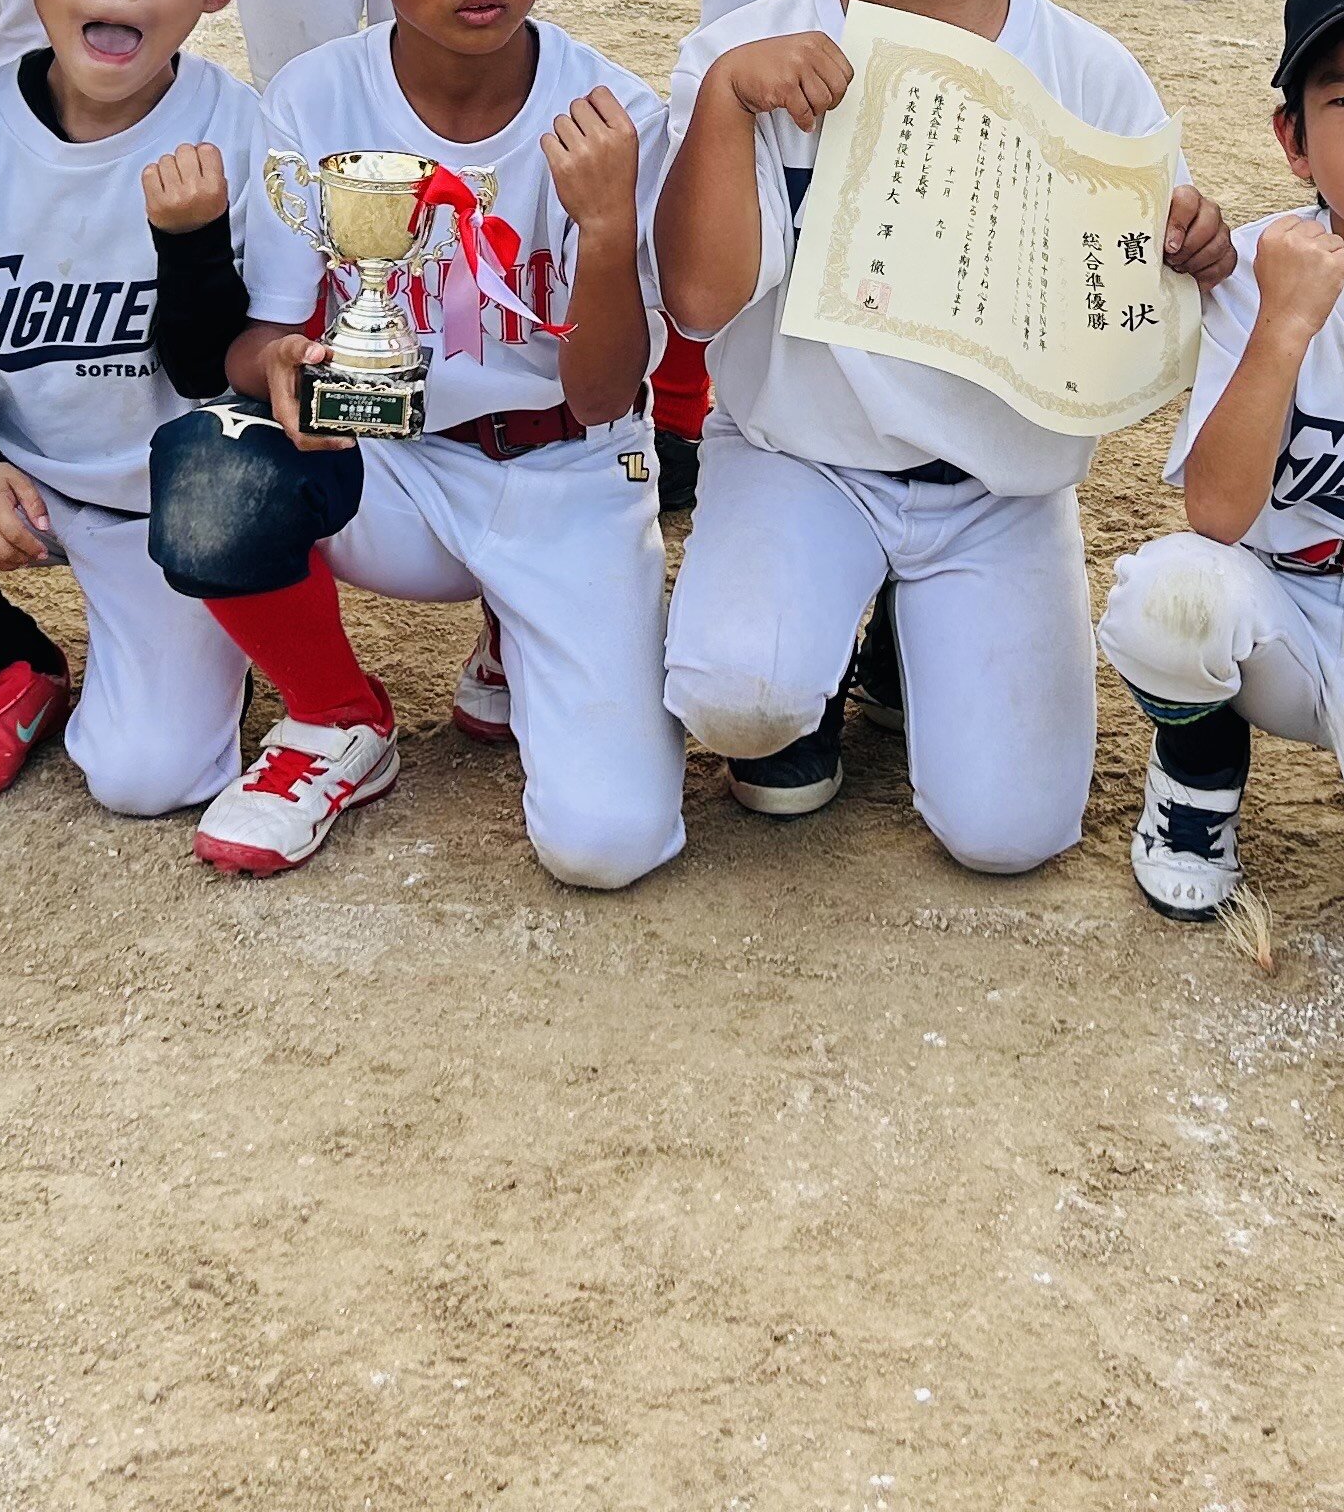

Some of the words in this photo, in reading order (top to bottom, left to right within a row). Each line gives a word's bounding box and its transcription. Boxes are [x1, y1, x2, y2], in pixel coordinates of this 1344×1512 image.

[915, 93, 945, 199] 株式会社テレビ長崎
[1081, 231, 1110, 331] 総合準優勝
[1116, 231, 1160, 332] 賞状
[75, 361, 162, 378] SOFTBA
